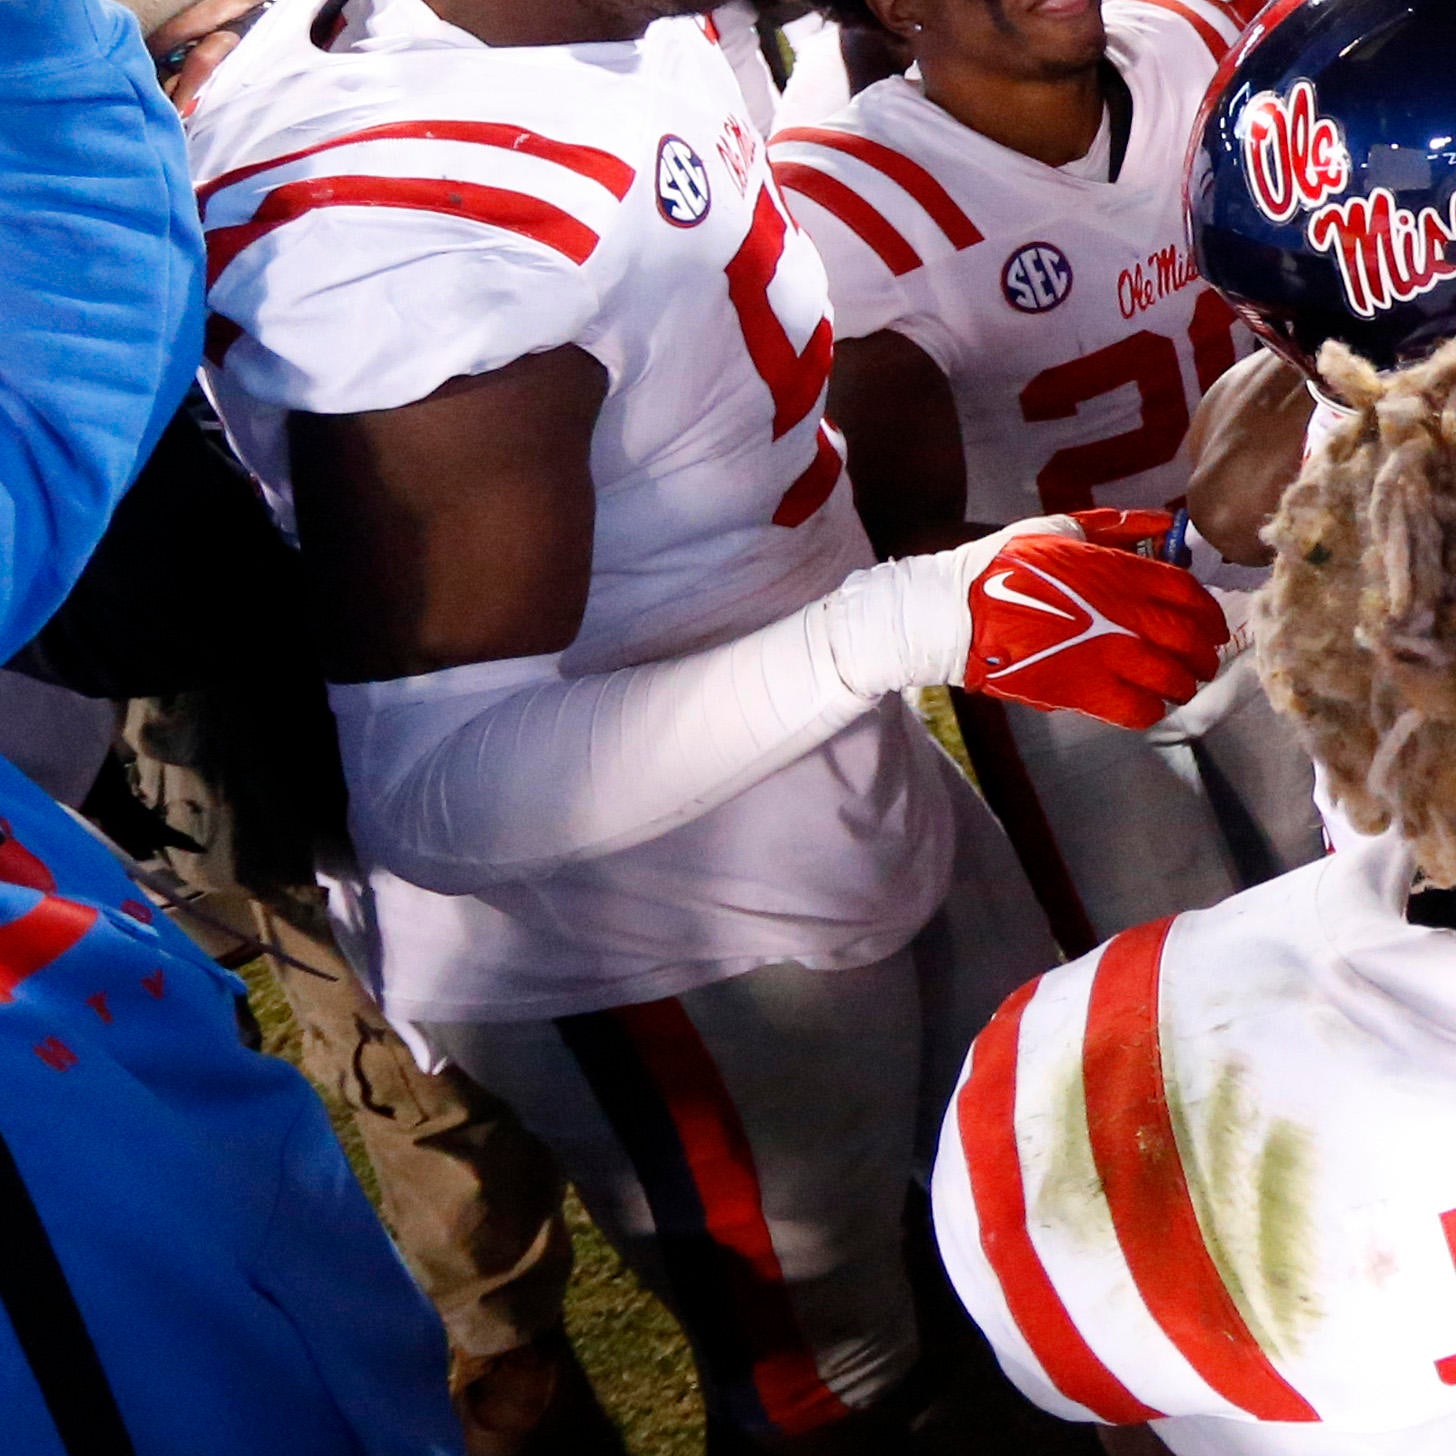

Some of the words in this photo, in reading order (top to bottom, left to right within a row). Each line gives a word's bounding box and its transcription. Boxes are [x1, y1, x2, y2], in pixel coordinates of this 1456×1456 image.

[657, 136, 710, 226] SEC
[1239, 76, 1351, 224] Ole
[1004, 245, 1070, 311] SEC
[1117, 262, 1155, 320] Ole
[1147, 244, 1199, 300] Mis
